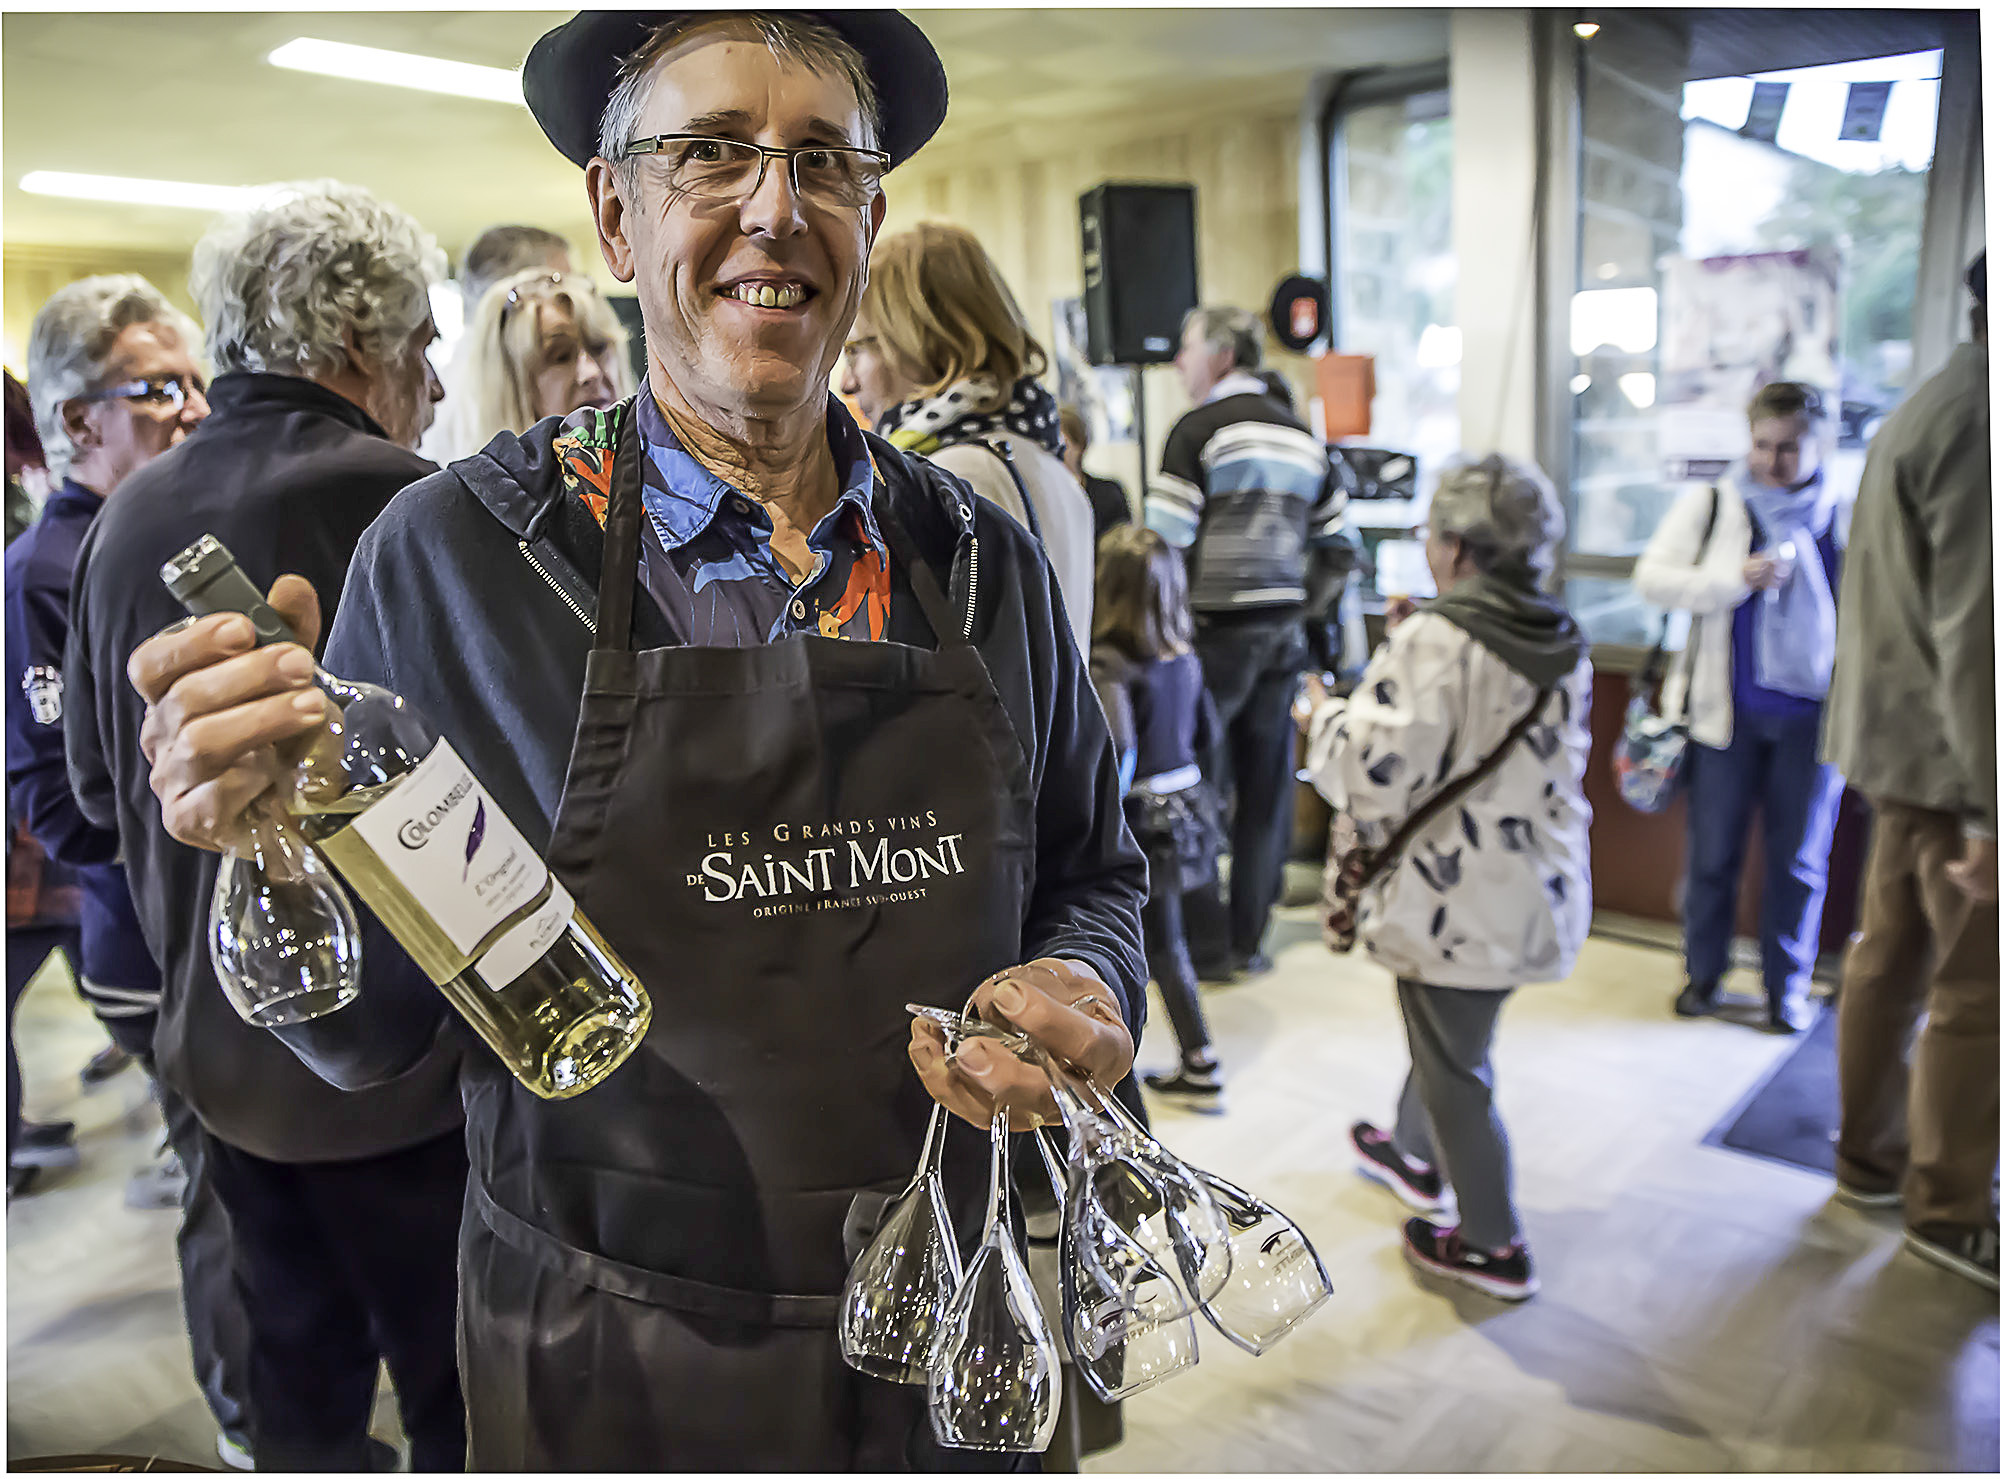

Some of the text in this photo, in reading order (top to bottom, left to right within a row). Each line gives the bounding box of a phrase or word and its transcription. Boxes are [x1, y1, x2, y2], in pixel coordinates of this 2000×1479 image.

[708, 810, 937, 848] LES GRANDS VINS
[686, 874, 705, 886] DE
[846, 833, 965, 888] MONT
